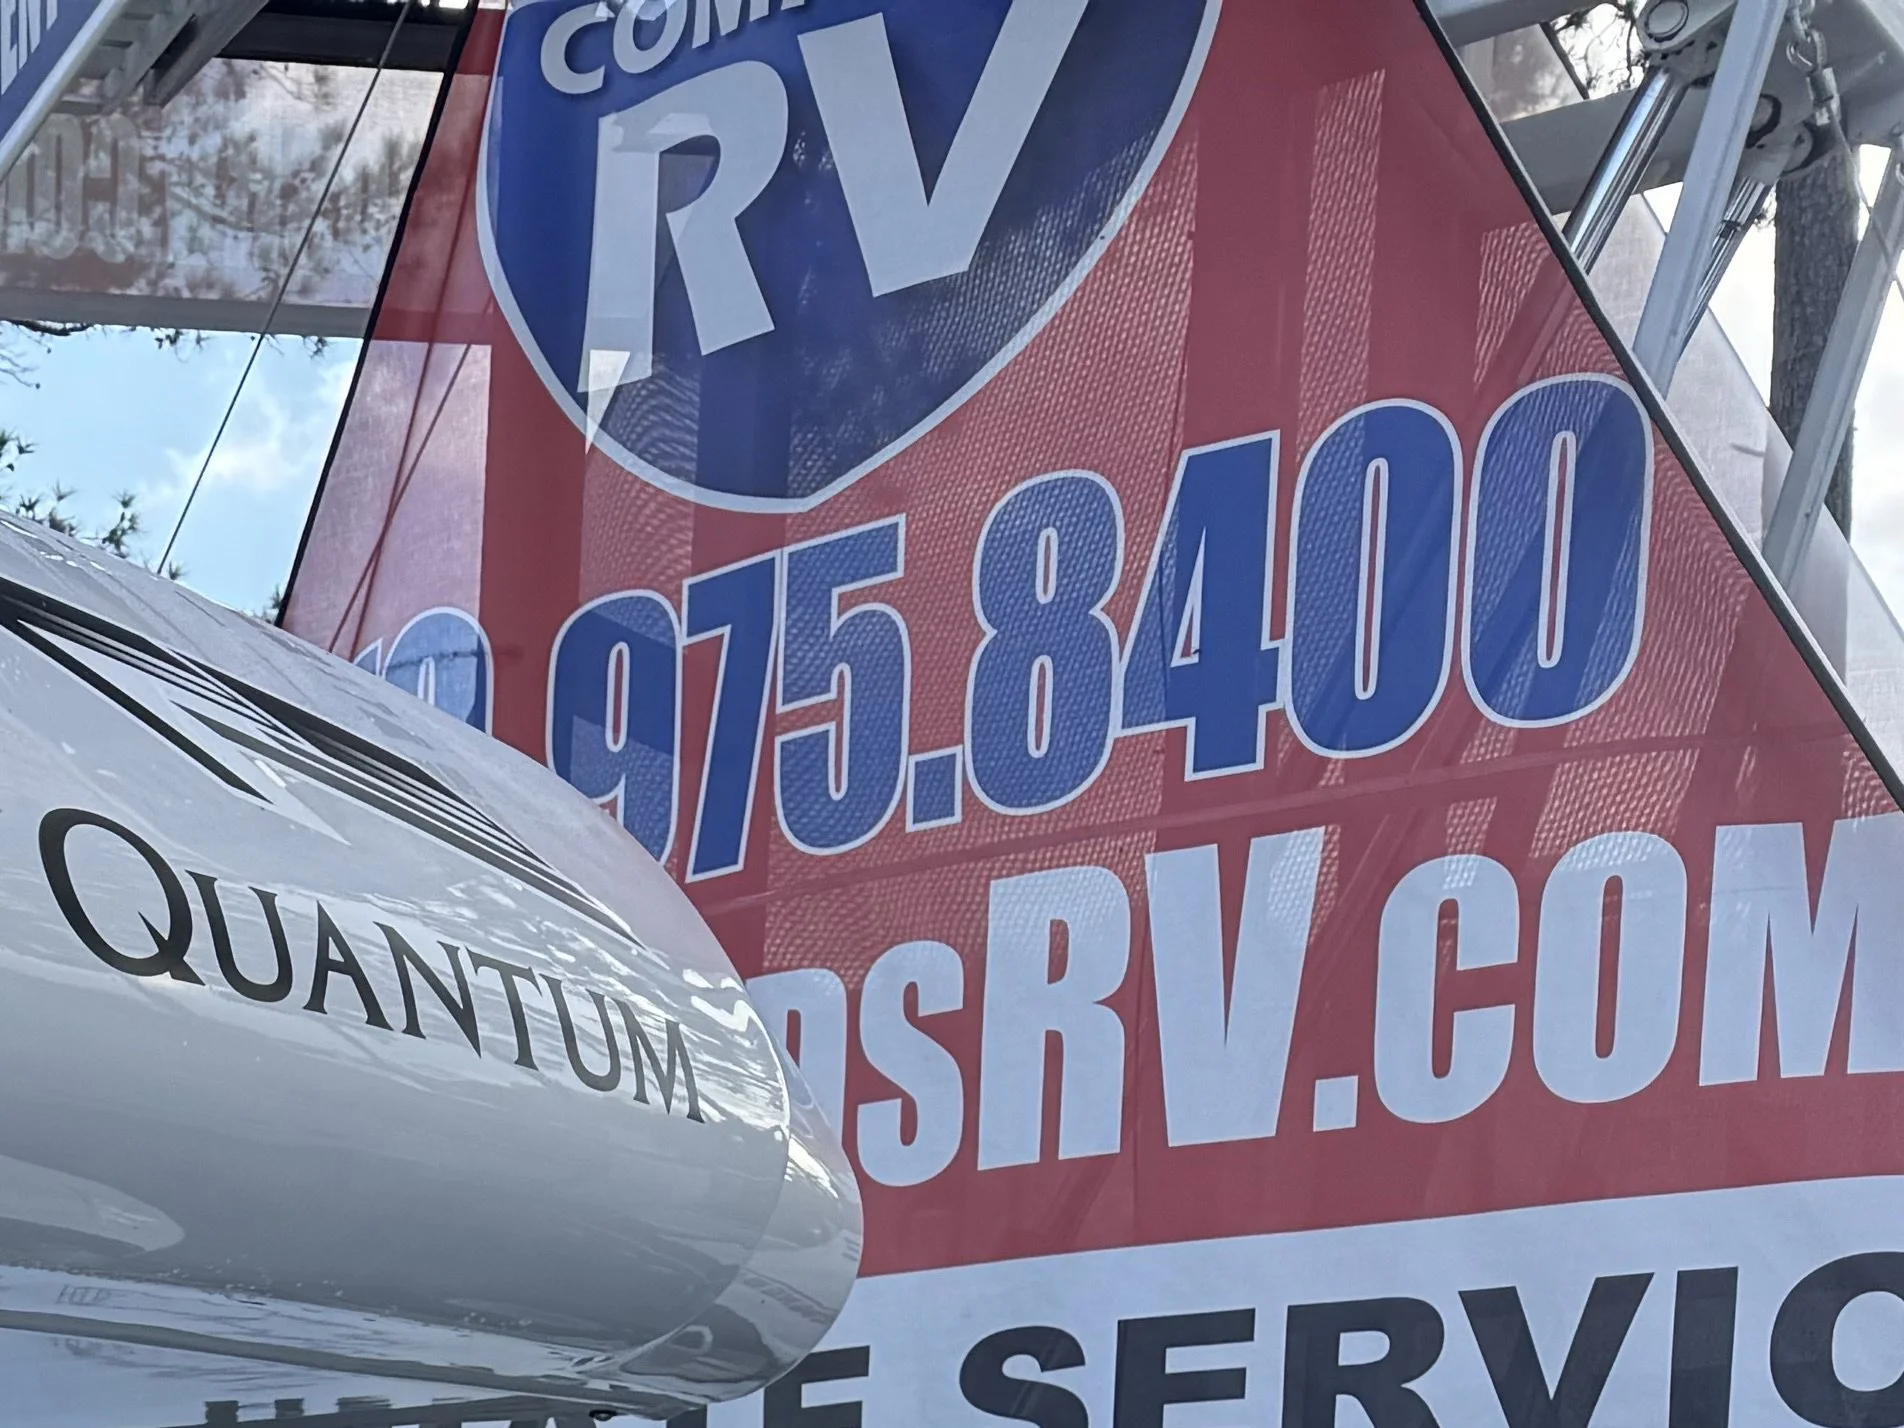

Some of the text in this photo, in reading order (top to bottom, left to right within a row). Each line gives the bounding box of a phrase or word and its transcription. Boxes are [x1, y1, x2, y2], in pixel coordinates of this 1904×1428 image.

[540, 0, 805, 95] COM
[577, 0, 1088, 394] RV
[38, 808, 705, 1123] QUANTUM
